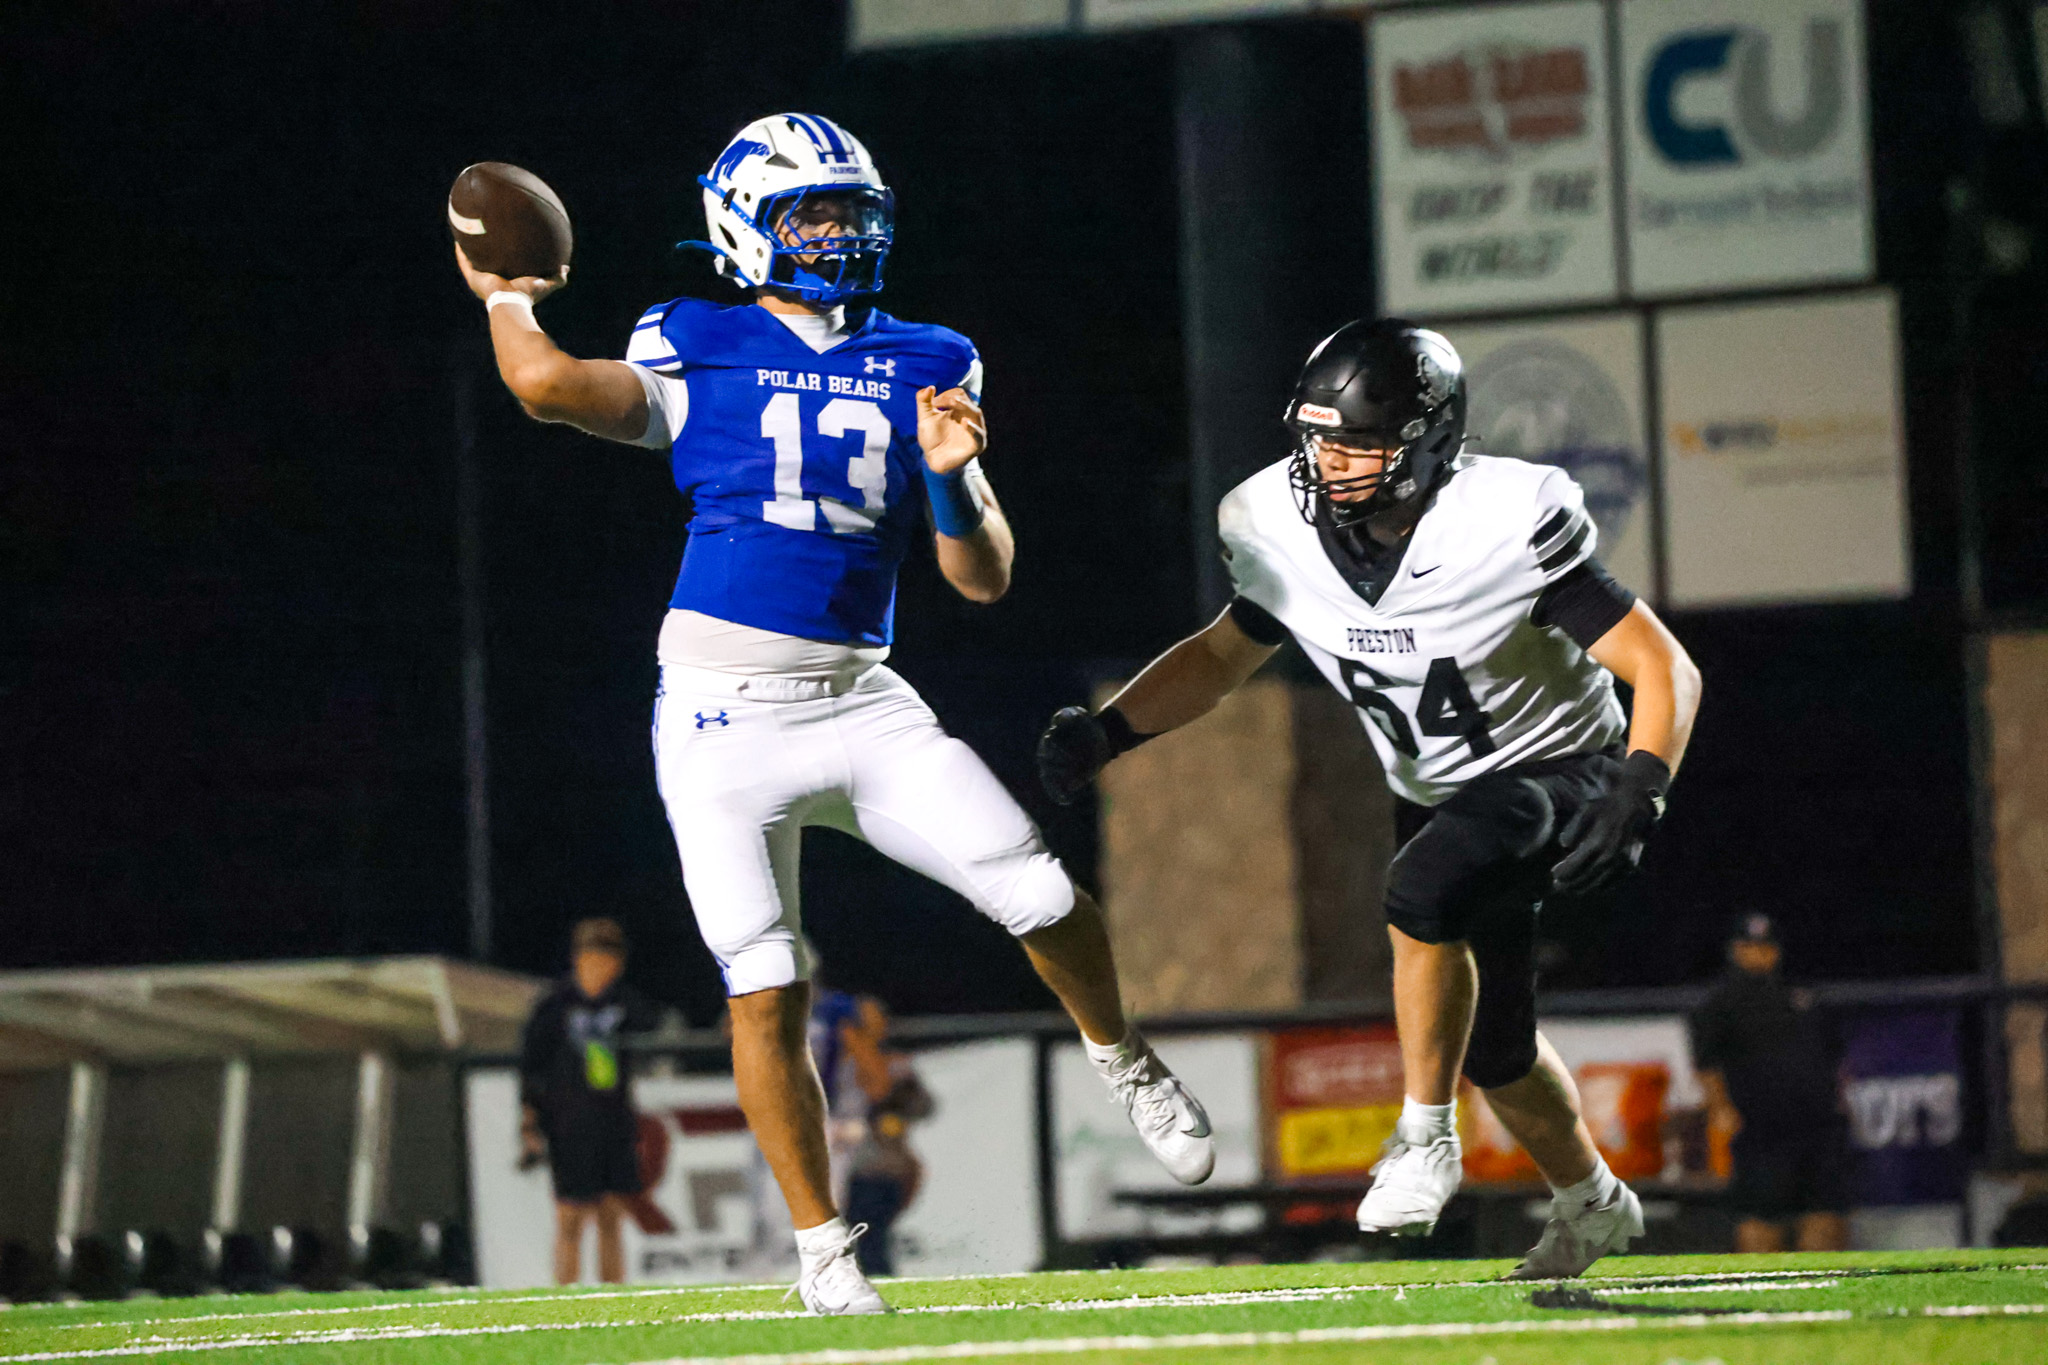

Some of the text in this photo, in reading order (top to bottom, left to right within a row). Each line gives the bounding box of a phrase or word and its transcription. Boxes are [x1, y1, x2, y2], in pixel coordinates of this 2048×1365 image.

[1642, 20, 1842, 173] CU
[757, 369, 891, 400] POLAR BEARS
[761, 392, 891, 534] 13
[1347, 628, 1416, 653] PRESTON
[1337, 655, 1502, 759] 64
